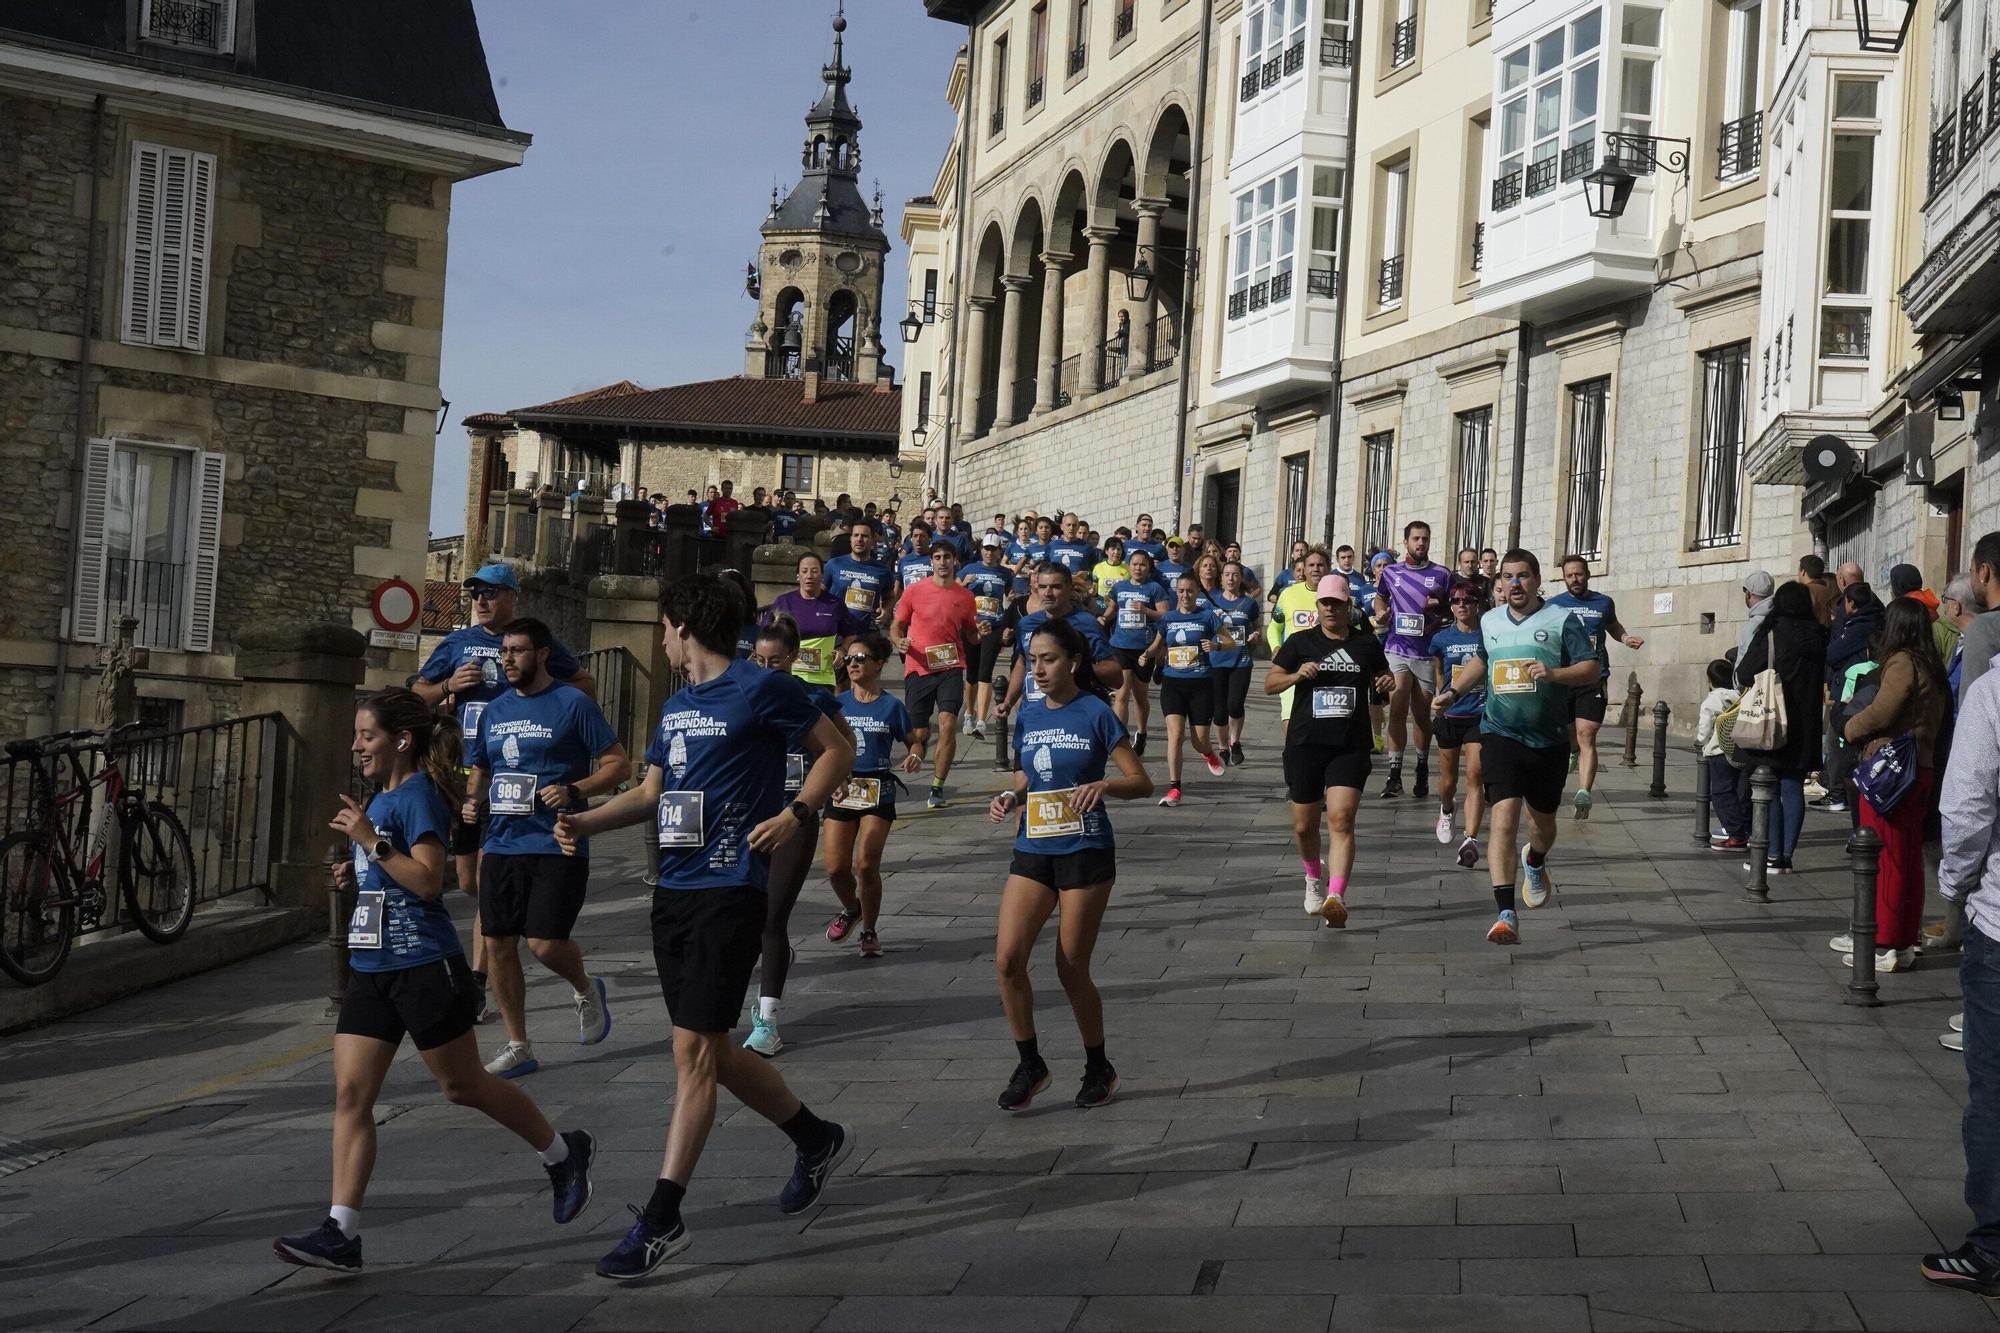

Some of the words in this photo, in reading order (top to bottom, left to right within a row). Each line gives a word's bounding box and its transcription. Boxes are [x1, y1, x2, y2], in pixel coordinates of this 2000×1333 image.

[1936, 505, 1942, 515] 2
[1401, 618, 1418, 628] 1057
[471, 650, 501, 658] ALMEN
[1319, 660, 1360, 673] adidas
[1505, 667, 1520, 680] 49
[1322, 693, 1348, 706] 1022
[498, 719, 531, 729] CONQUISTA
[665, 716, 714, 732] ALMENDRA
[850, 720, 885, 728] MENDRA
[496, 724, 543, 736] ALMENDRA
[518, 731, 552, 739] KONKISTA
[686, 727, 727, 737] KONKISTA
[1028, 728, 1065, 738] CONQUISTA
[1027, 733, 1079, 746] ALMENDRA
[1051, 742, 1091, 751] KONKISTA
[497, 783, 522, 799] 986
[661, 805, 683, 826] 914
[1038, 801, 1063, 820] 457
